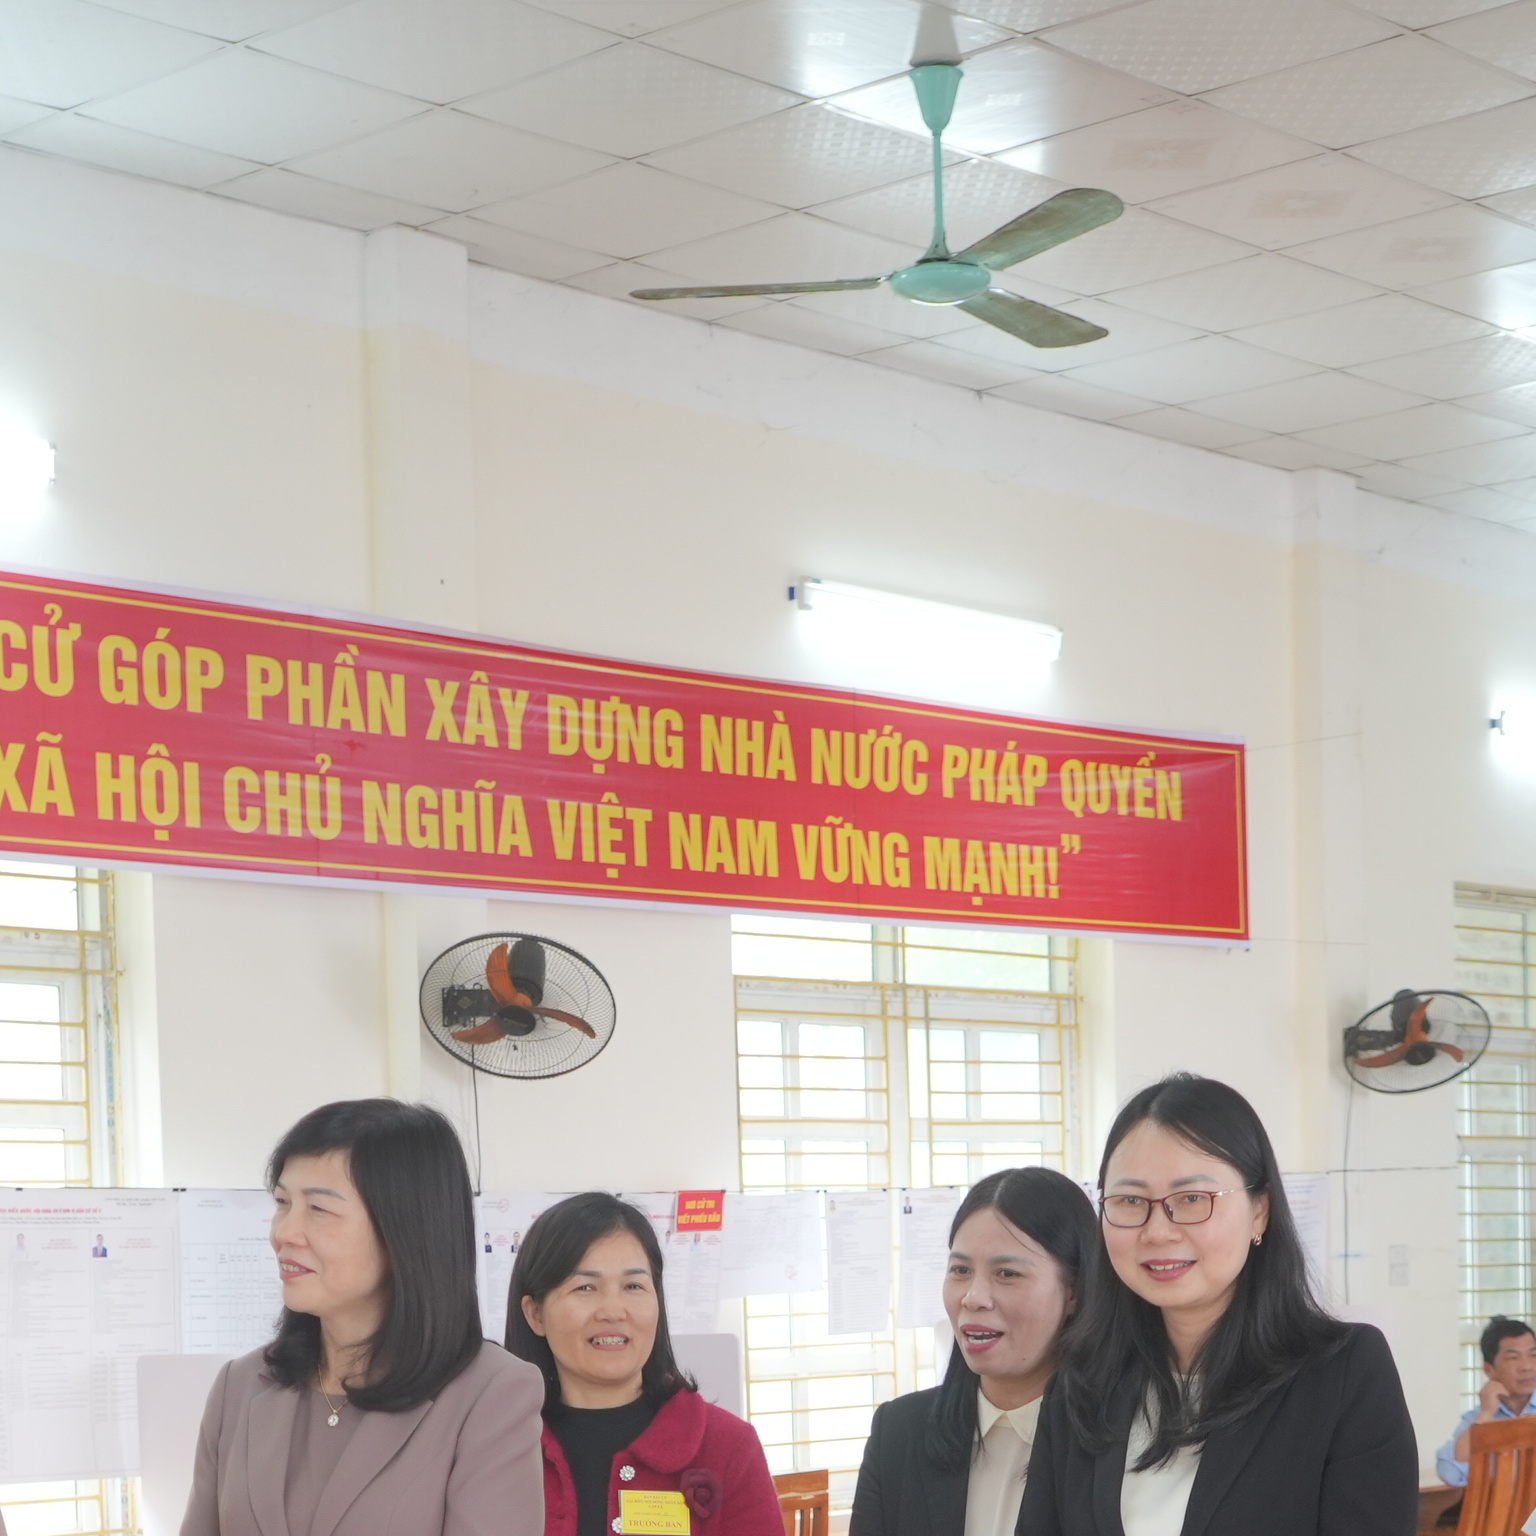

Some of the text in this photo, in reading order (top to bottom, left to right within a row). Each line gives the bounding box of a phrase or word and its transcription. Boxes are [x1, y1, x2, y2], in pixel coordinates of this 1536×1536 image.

[98, 628, 225, 713] GÓP
[247, 644, 407, 737] PHẦN
[426, 671, 529, 750] XÂY
[548, 694, 684, 774] DỰNG
[701, 711, 797, 782] NHÀ
[811, 724, 930, 796] NƯỚC
[943, 741, 1049, 807] PHÁP
[96, 744, 202, 841] HỘI
[224, 754, 343, 840] CHỦ
[363, 780, 533, 857] NGHĨA
[547, 792, 653, 879] VIỆT
[668, 811, 780, 878] NAM
[791, 815, 911, 888] VỮNG
